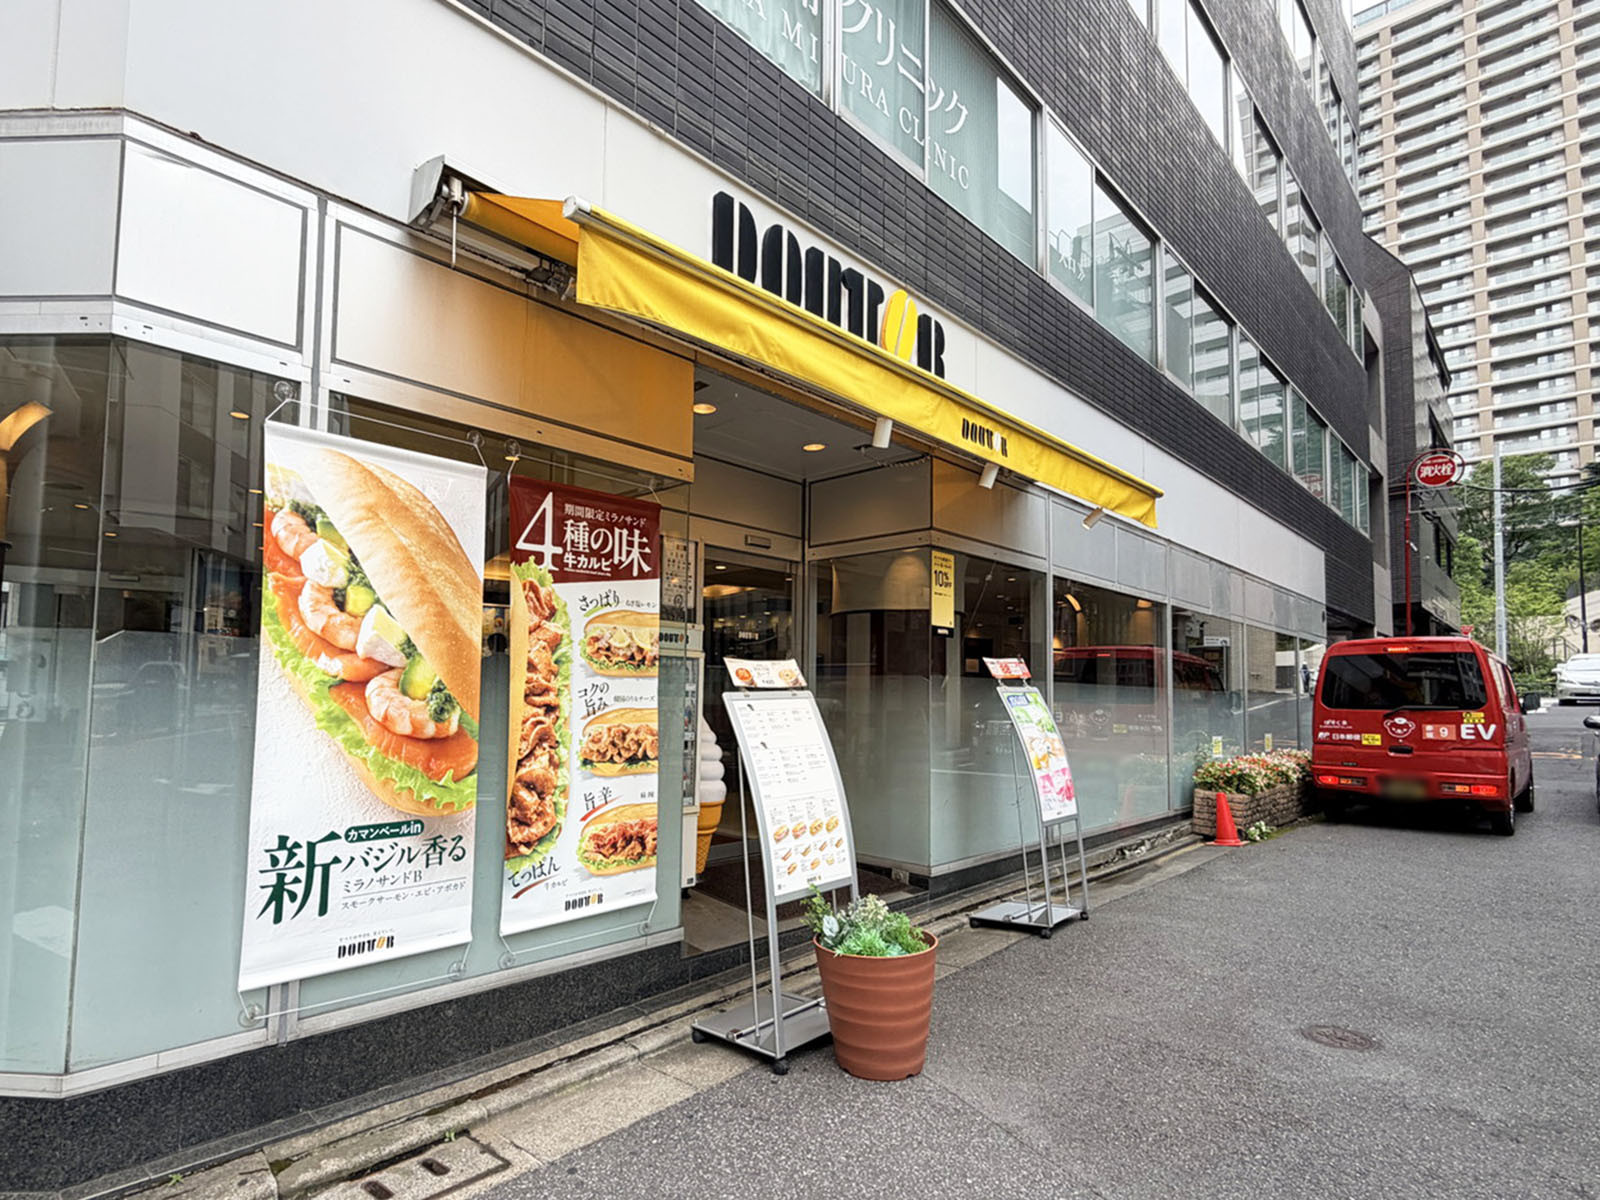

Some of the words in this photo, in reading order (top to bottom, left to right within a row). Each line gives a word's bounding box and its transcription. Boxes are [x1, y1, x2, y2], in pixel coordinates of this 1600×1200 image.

[899, 107, 969, 189] CLNIC
[712, 190, 945, 379] DOUTOR
[962, 417, 1008, 458] DOUTOR
[1420, 463, 1454, 478] 消火栓
[578, 588, 620, 612] さっぱり
[577, 681, 610, 699] コクの
[1460, 723, 1497, 740] EV
[341, 834, 467, 874] バジル香る
[256, 830, 343, 925] 新
[564, 892, 604, 912] DOUTOR
[337, 935, 395, 959] DOUTOR
